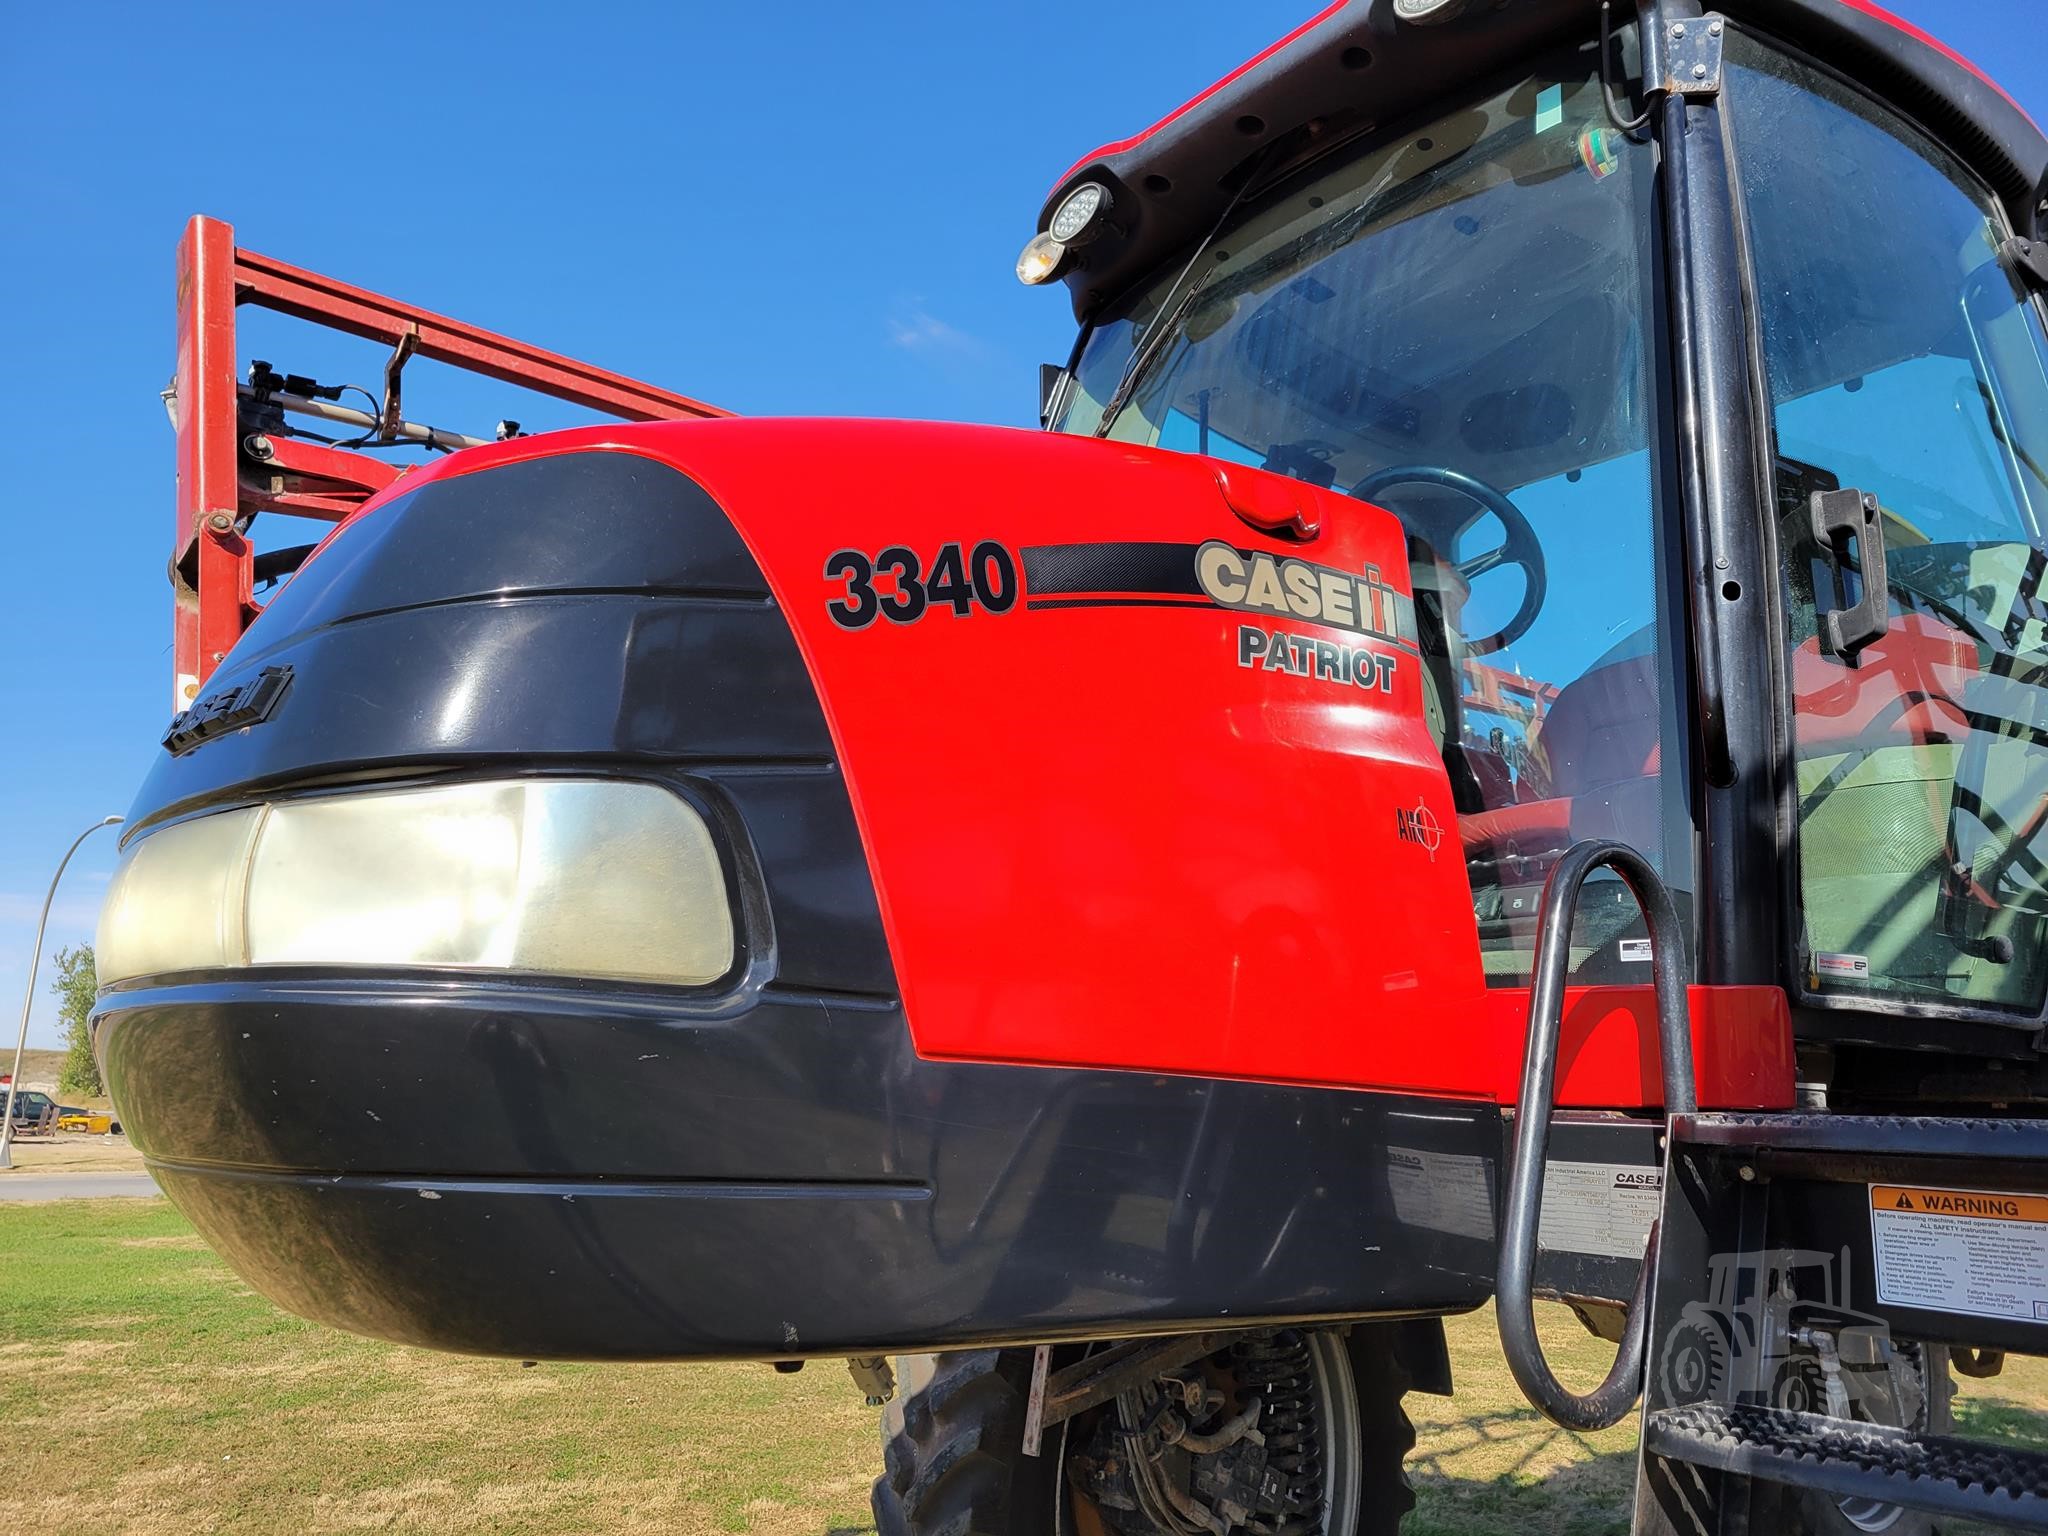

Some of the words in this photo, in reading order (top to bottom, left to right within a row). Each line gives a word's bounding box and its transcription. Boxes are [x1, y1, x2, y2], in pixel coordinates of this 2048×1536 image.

[824, 540, 1018, 631] 3340
[1238, 626, 1397, 693] PATRIOT
[1616, 1173, 1654, 1184] CASE
[1923, 1195, 2019, 1216] WARNING
